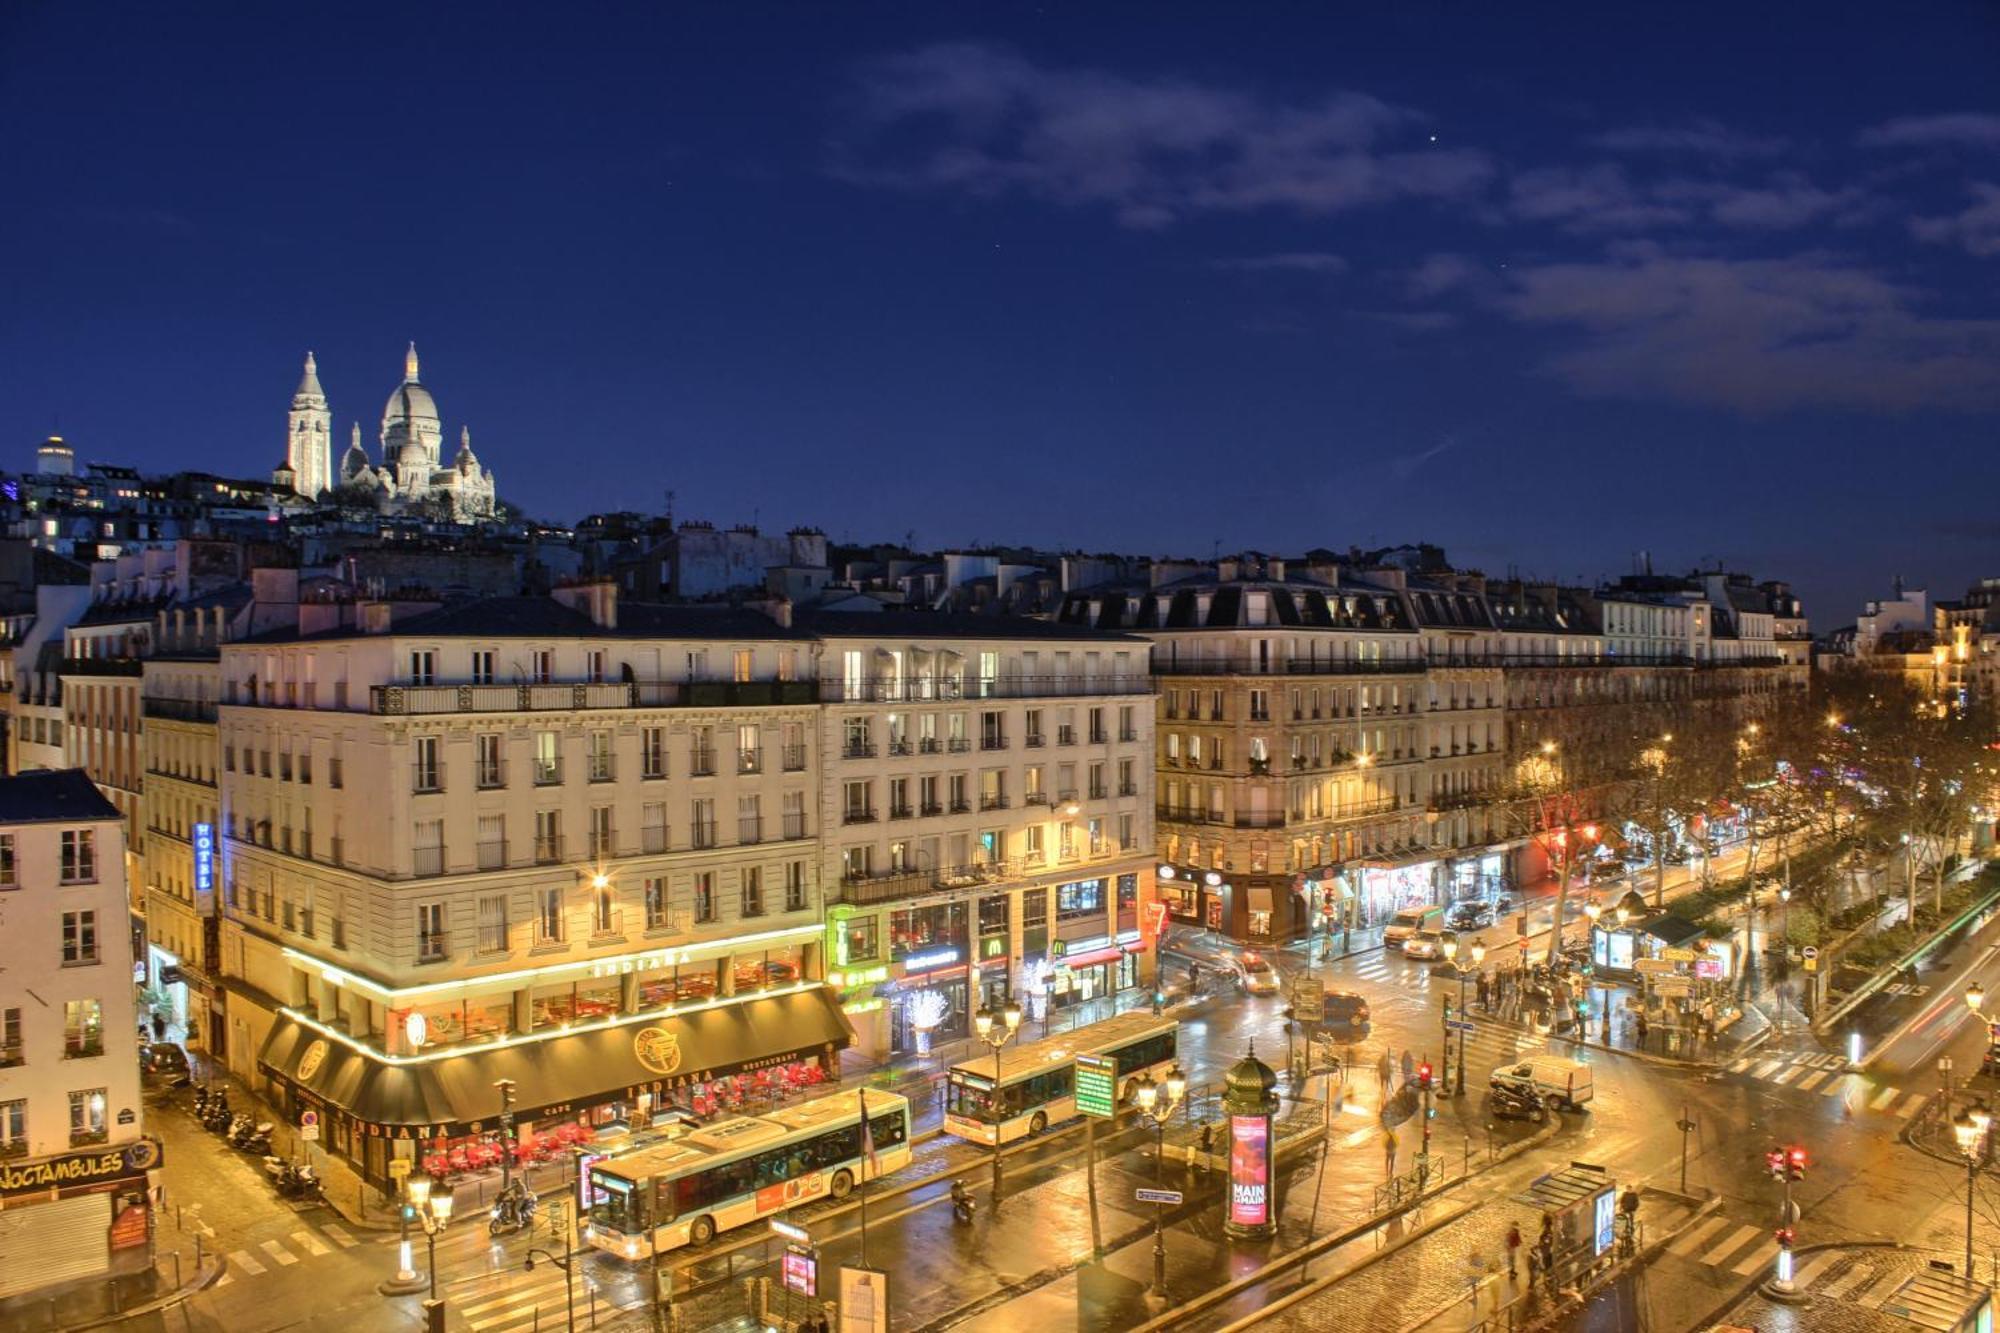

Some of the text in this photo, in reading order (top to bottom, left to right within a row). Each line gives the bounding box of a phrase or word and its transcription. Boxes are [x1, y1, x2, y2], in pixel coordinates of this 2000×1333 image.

[197, 823, 210, 888] HOTEL
[593, 951, 691, 978] INDIANA
[1885, 983, 1931, 997] BUS
[1791, 1051, 1847, 1070] BUS
[627, 1070, 713, 1098] INDIANA
[351, 1118, 448, 1138] INDIANA
[1233, 1183, 1264, 1197] MAIN
